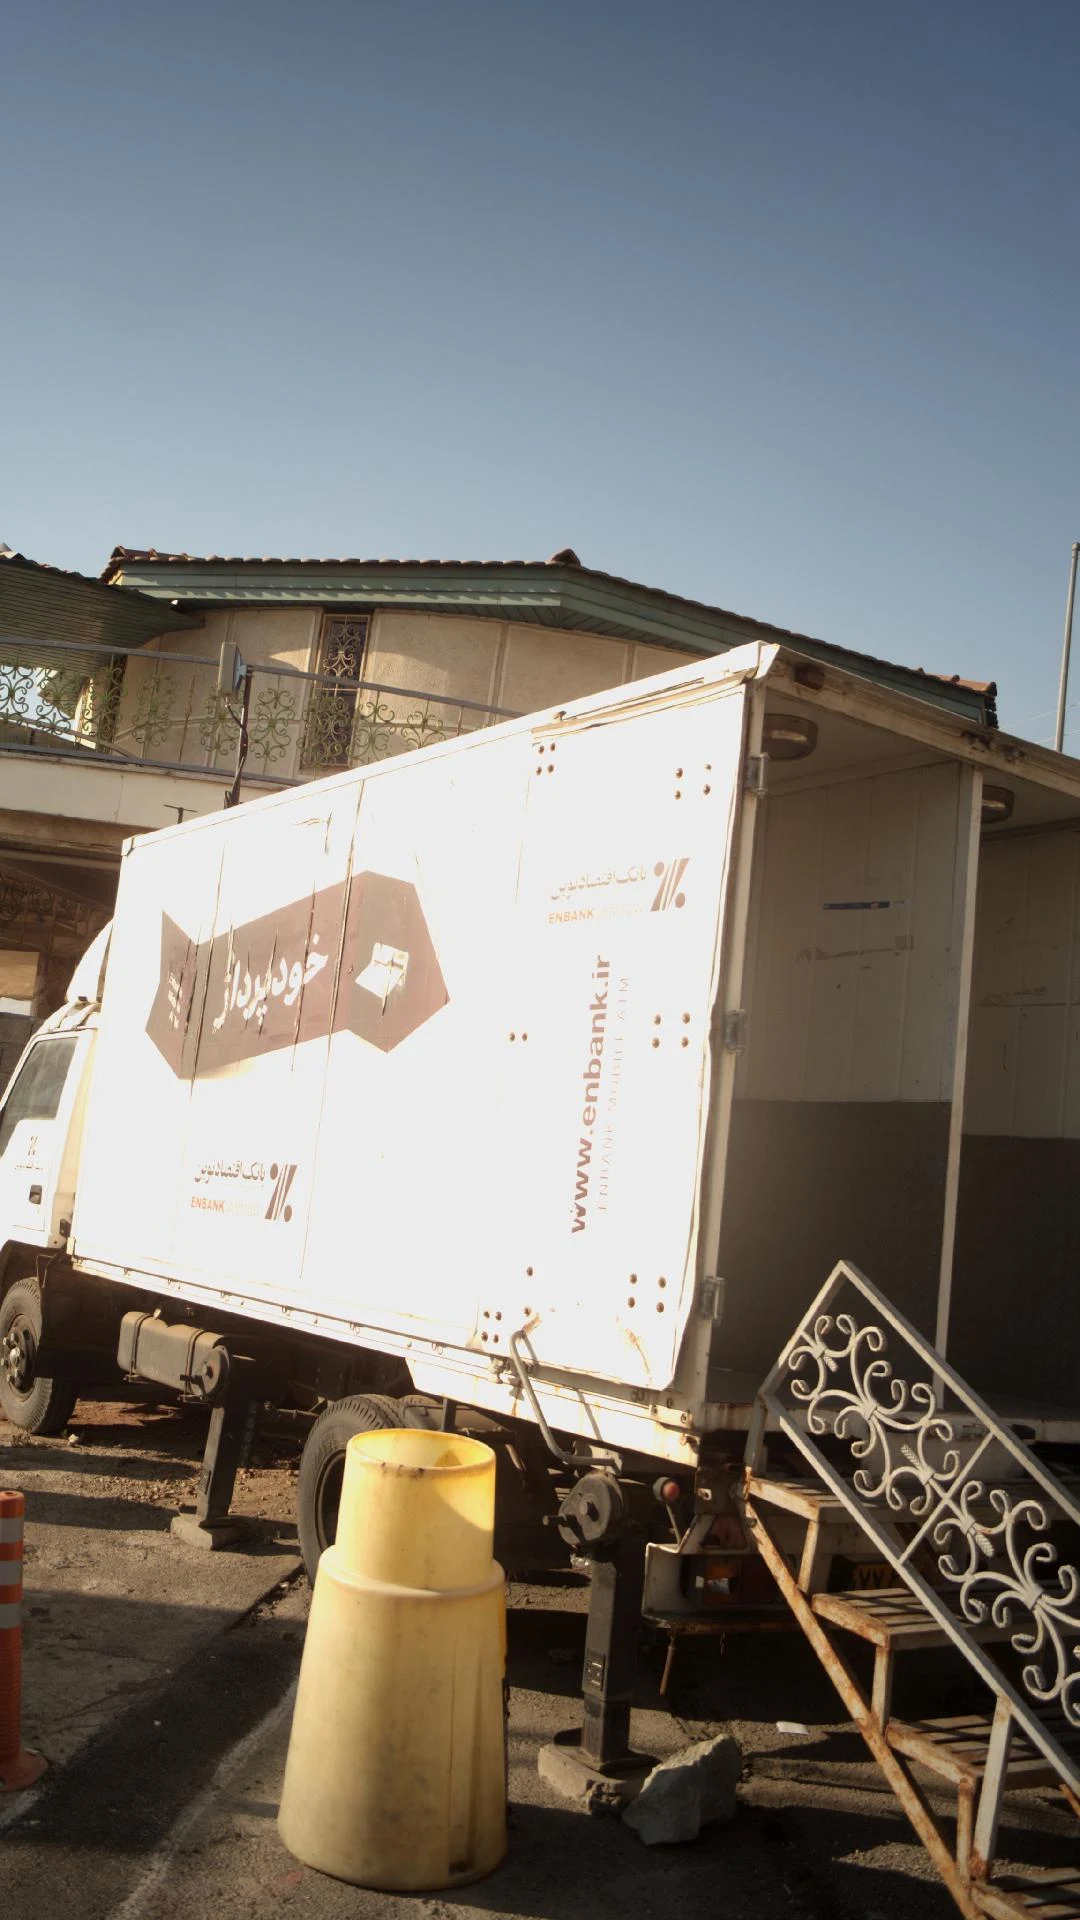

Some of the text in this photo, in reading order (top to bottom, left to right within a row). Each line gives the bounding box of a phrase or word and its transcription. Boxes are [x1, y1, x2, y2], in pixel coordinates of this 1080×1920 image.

[549, 909, 593, 924] ENBANK
[212, 933, 329, 1033] خودپرداز
[571, 954, 610, 1234] www.enbank.ir
[192, 1196, 225, 1212] ENBANK
